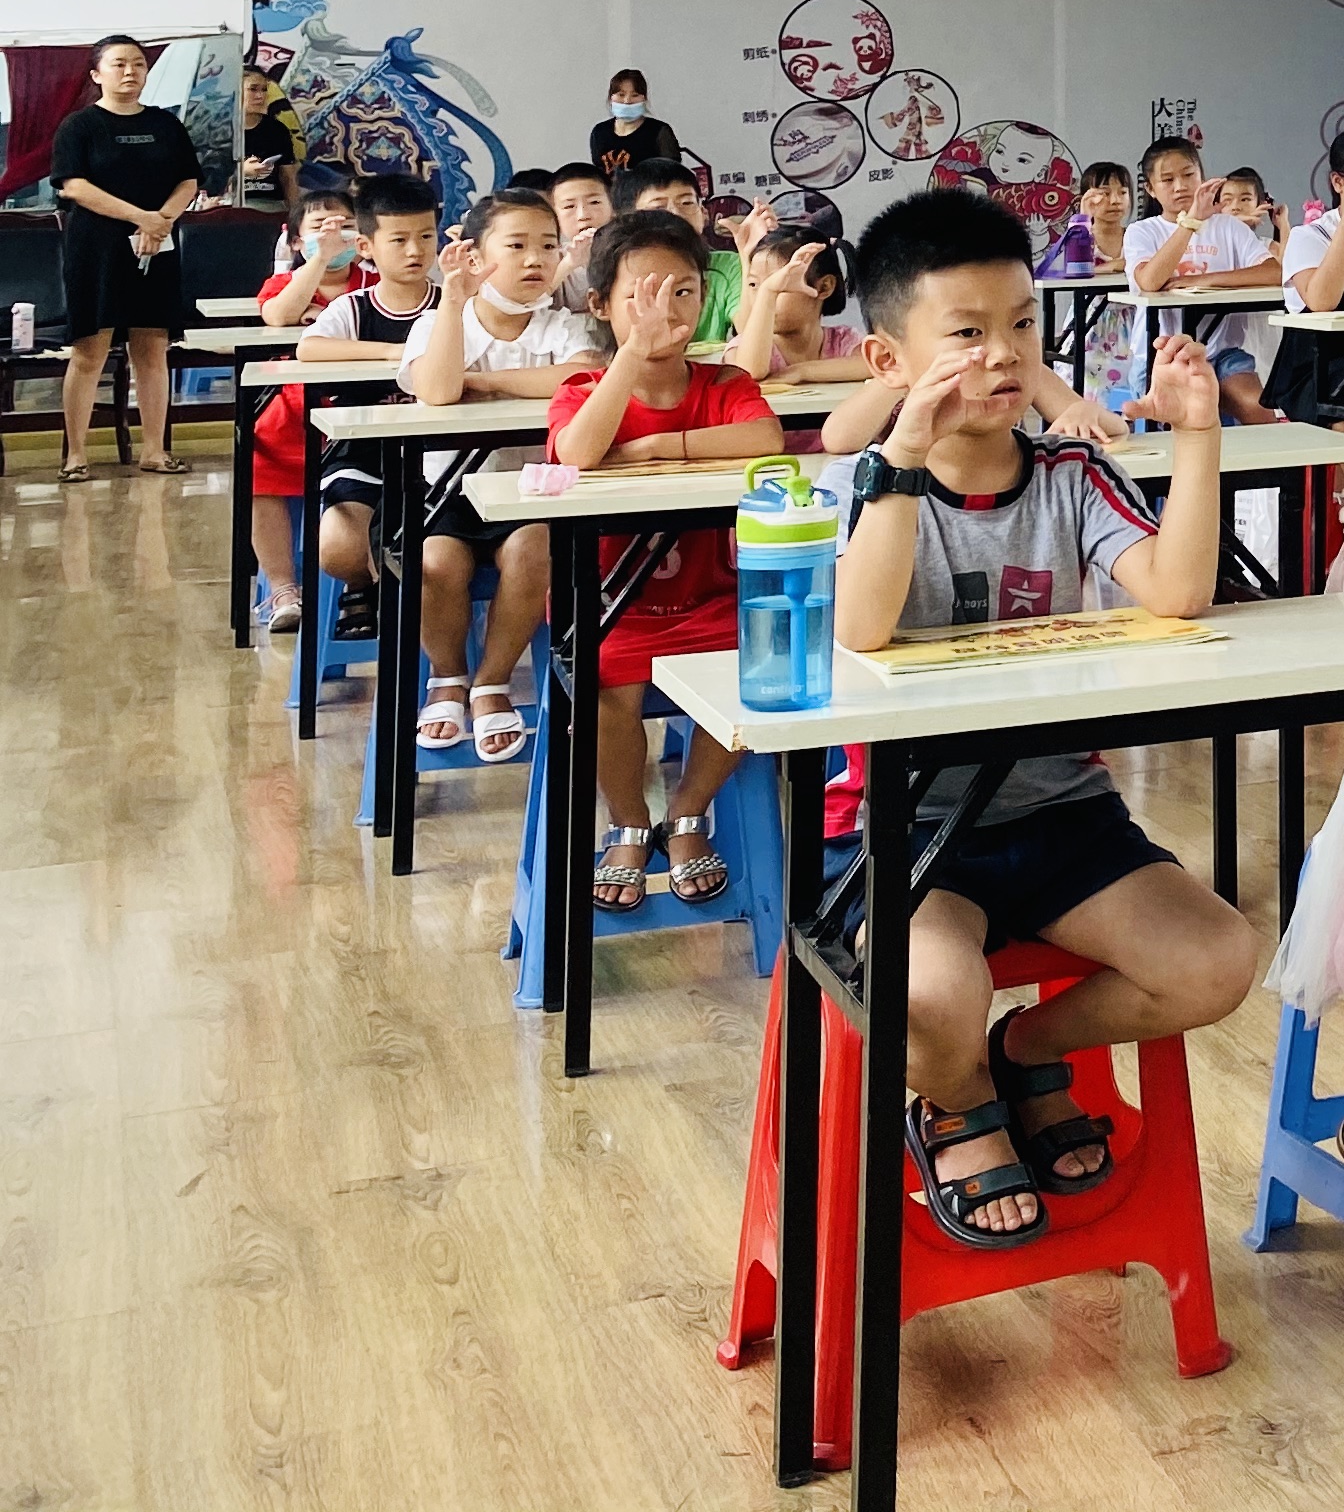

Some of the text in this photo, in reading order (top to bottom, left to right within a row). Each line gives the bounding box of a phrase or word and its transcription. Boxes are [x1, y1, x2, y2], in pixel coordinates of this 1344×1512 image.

[742, 46, 770, 61] 剪纸
[742, 109, 769, 124] 刺绣
[1186, 98, 1197, 121] The
[868, 168, 895, 182] 皮影
